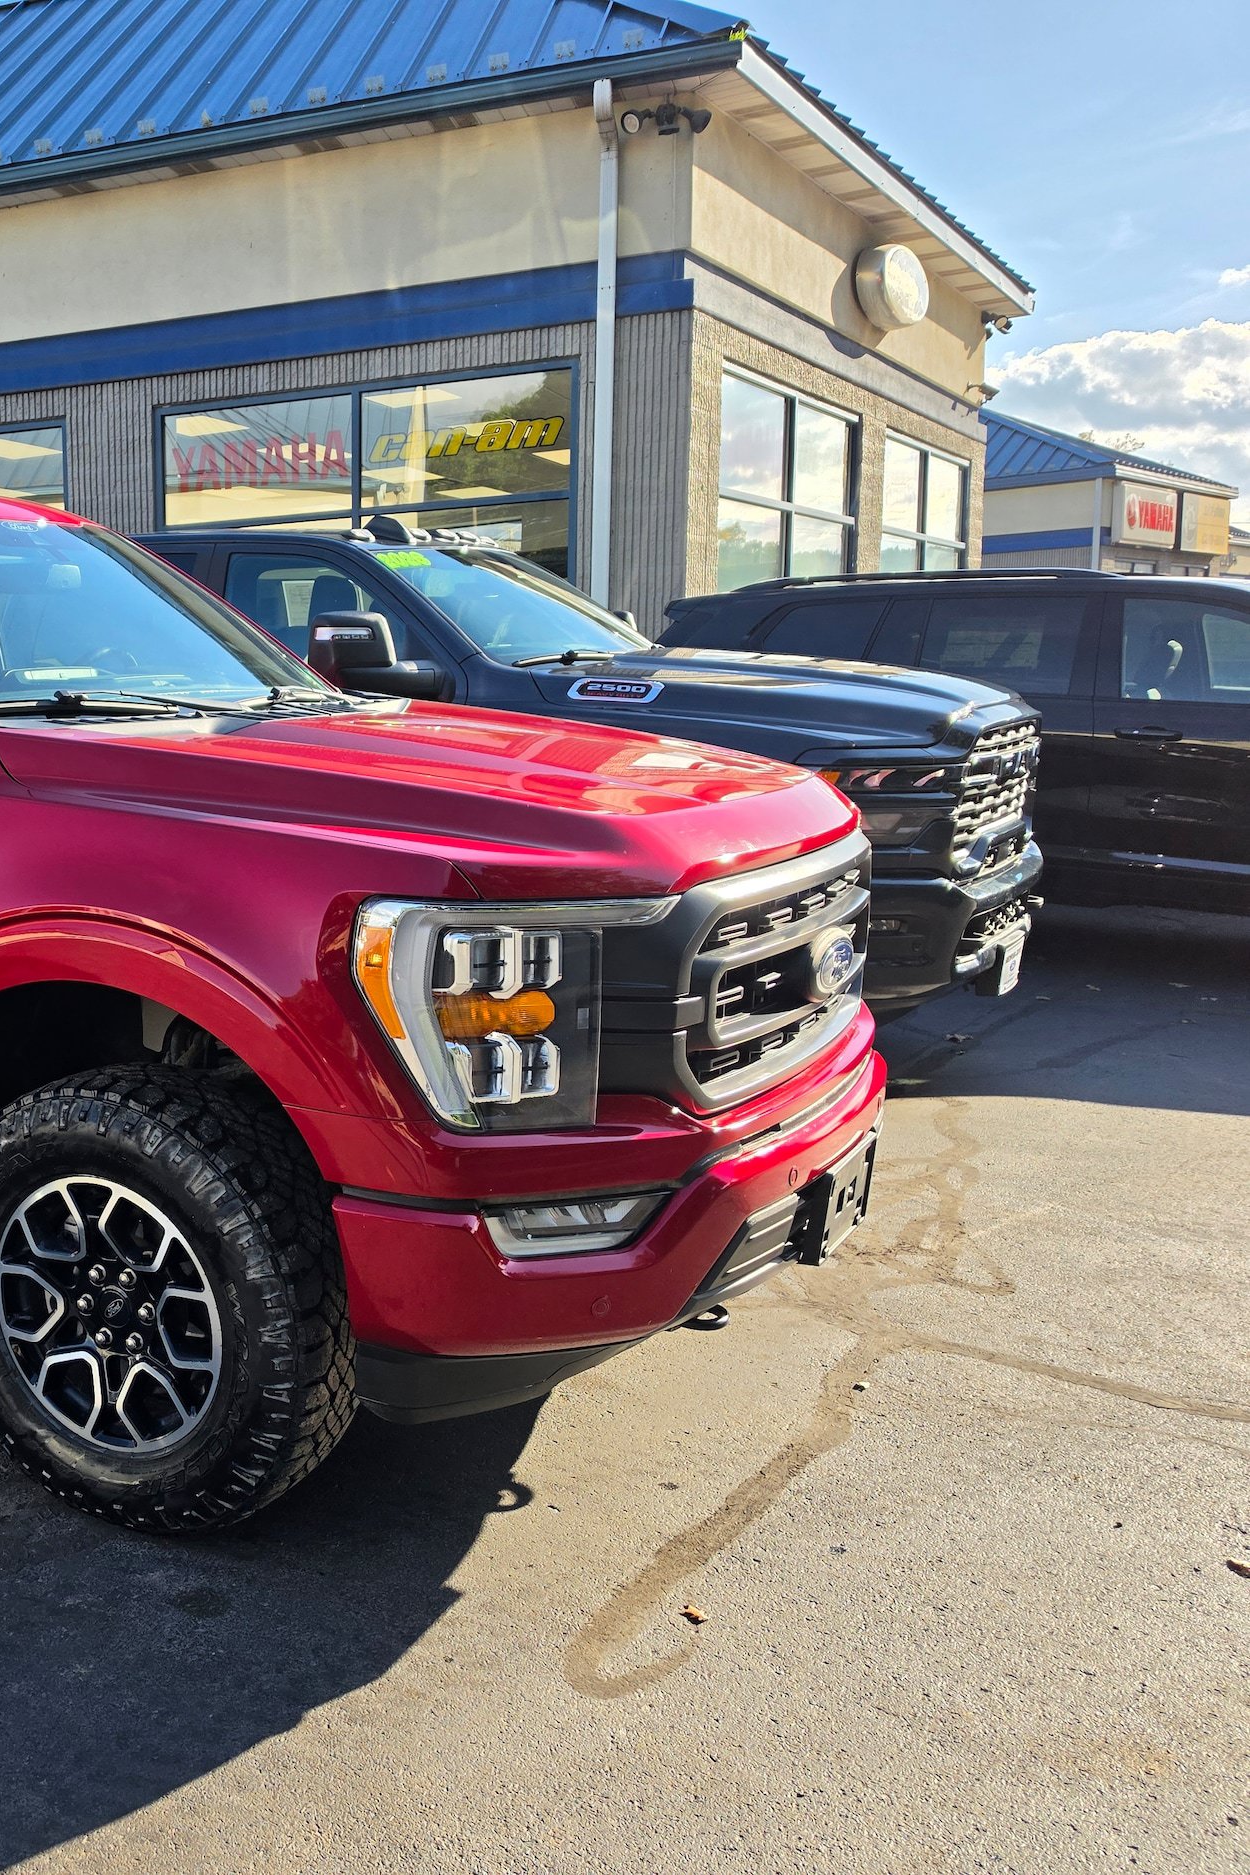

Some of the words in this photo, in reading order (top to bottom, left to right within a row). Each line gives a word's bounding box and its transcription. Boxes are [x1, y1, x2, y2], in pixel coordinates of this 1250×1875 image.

[368, 415, 565, 464] can-am
[172, 430, 348, 493] YAMAHA
[1138, 499, 1174, 533] YAMAHA
[587, 683, 646, 693] 2500
